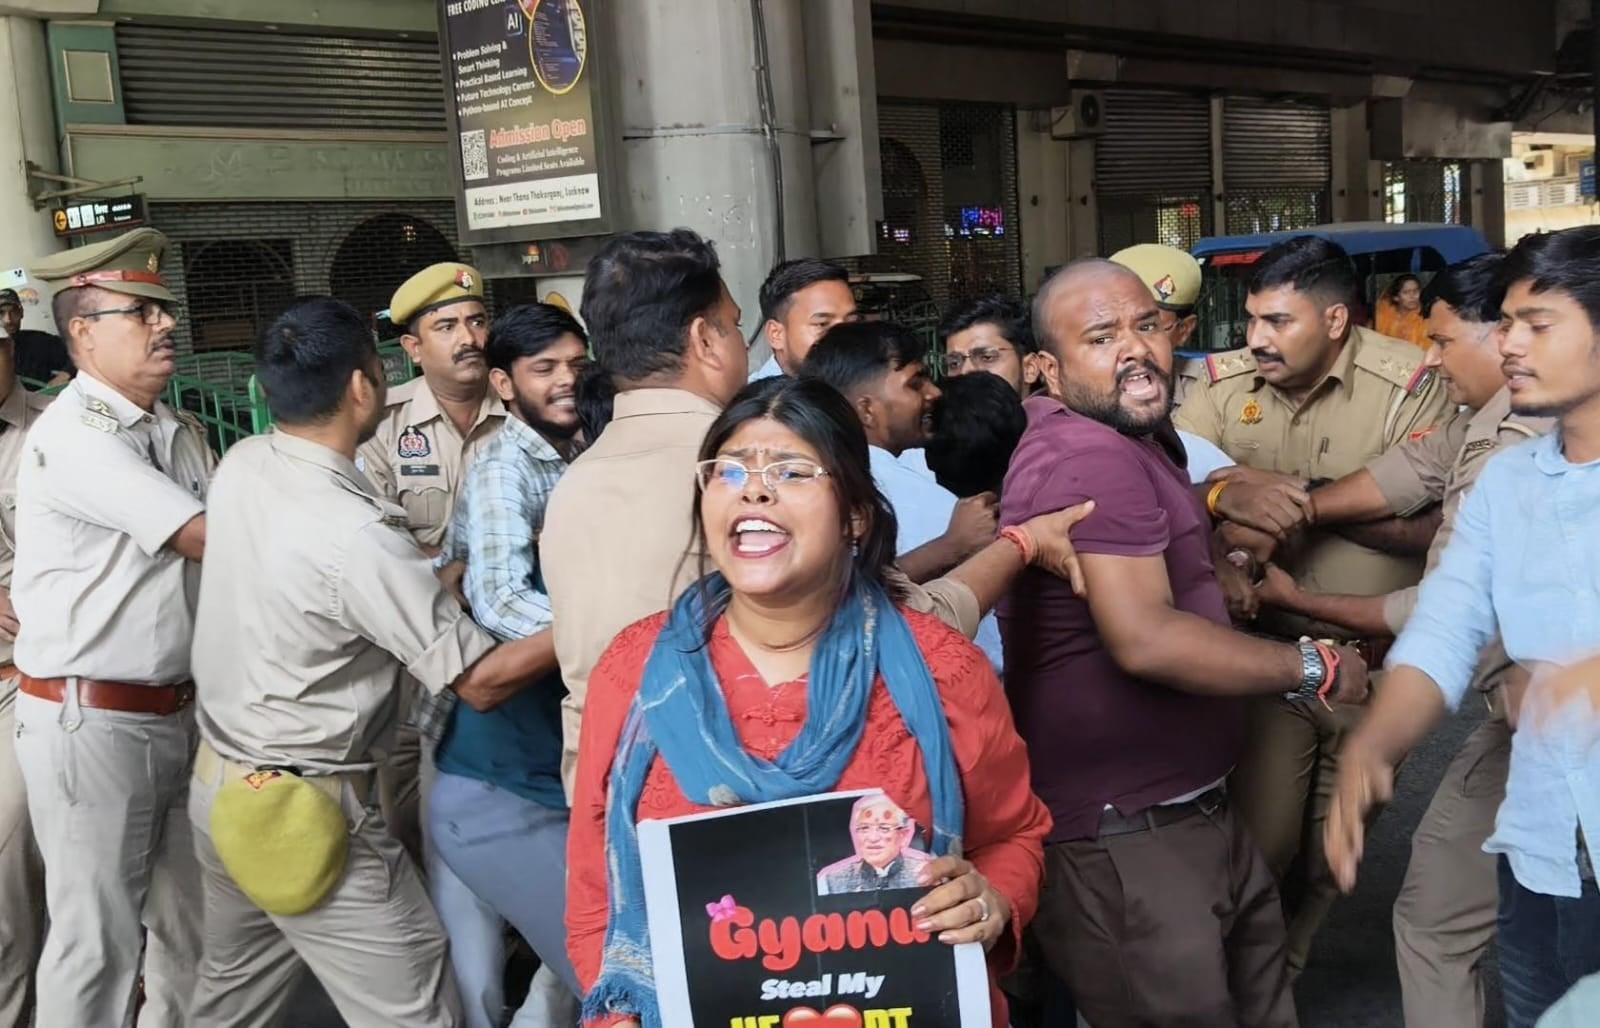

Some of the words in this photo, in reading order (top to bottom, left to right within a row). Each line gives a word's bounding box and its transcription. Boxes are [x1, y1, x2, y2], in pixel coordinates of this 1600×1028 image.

[448, 2, 462, 16] FREE
[508, 12, 518, 30] AI
[457, 48, 480, 60] Problem
[480, 42, 502, 55] Solving
[458, 63, 475, 75] Smart
[475, 58, 500, 71] Thinking
[460, 74, 484, 89] Practical
[484, 71, 501, 84] Based
[502, 67, 527, 80] Learning
[461, 92, 479, 103] Future
[480, 85, 512, 98] Technology
[512, 80, 536, 92] Careers
[509, 94, 534, 108] Concept
[490, 123, 550, 149] Admission
[551, 118, 586, 143] Open
[545, 145, 579, 158] Intelligence
[709, 905, 931, 971] Gyanu
[760, 973, 830, 1001] Steal
[837, 971, 886, 999] My
